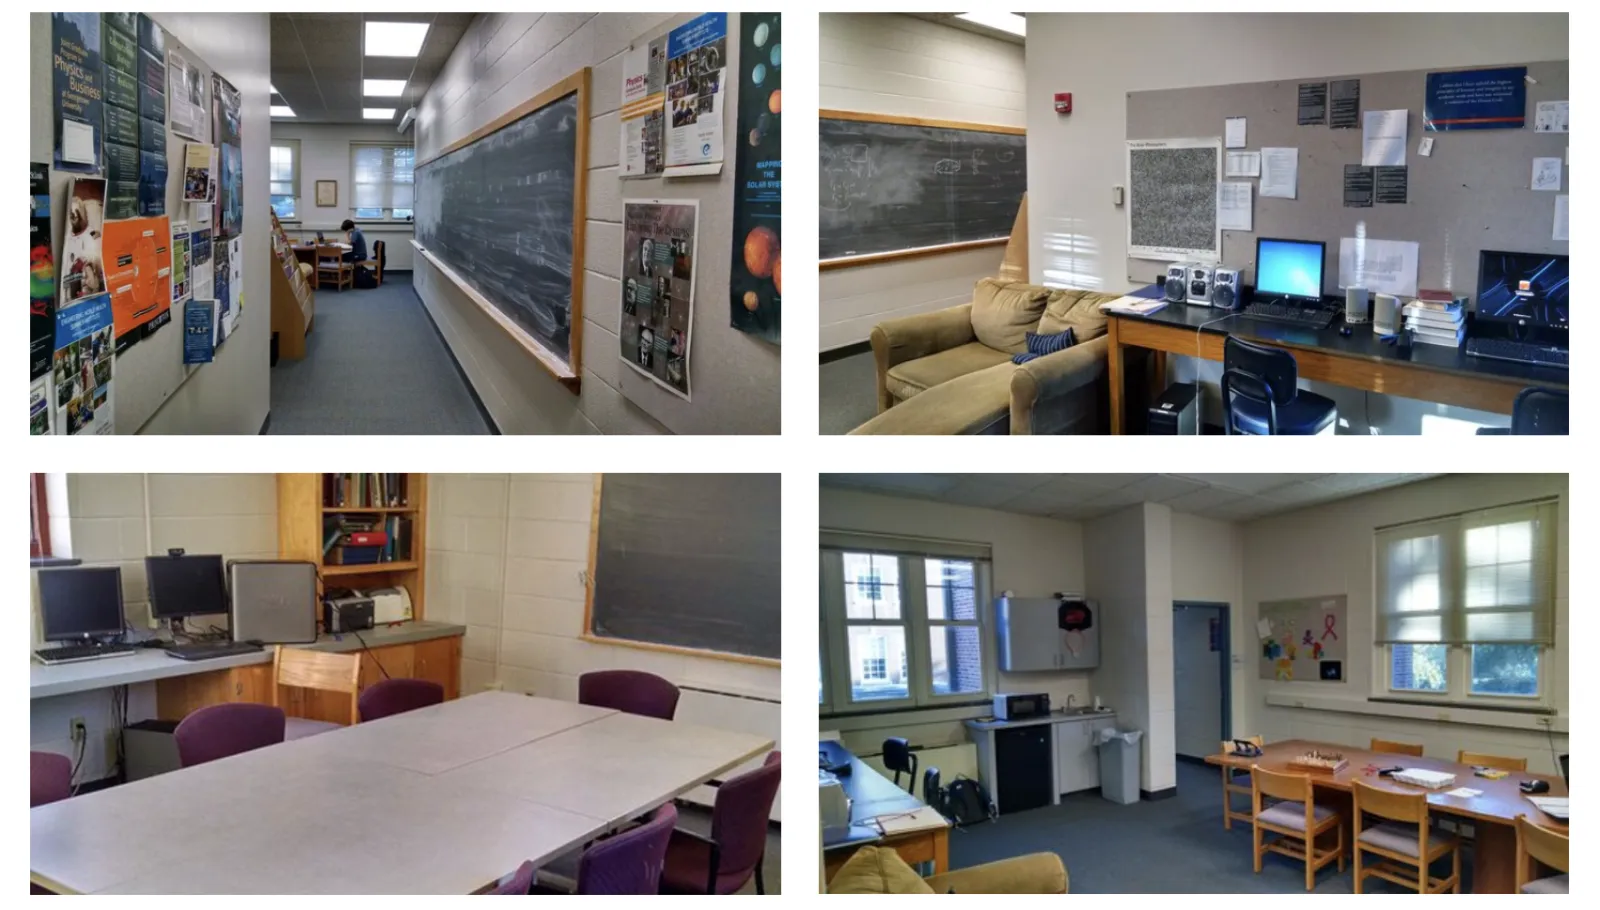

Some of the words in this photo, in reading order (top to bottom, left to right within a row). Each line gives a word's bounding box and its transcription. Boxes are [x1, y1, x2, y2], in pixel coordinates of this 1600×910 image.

[55, 54, 84, 79] Physics
[70, 75, 101, 101] Business
[747, 180, 767, 189] SOLAR
